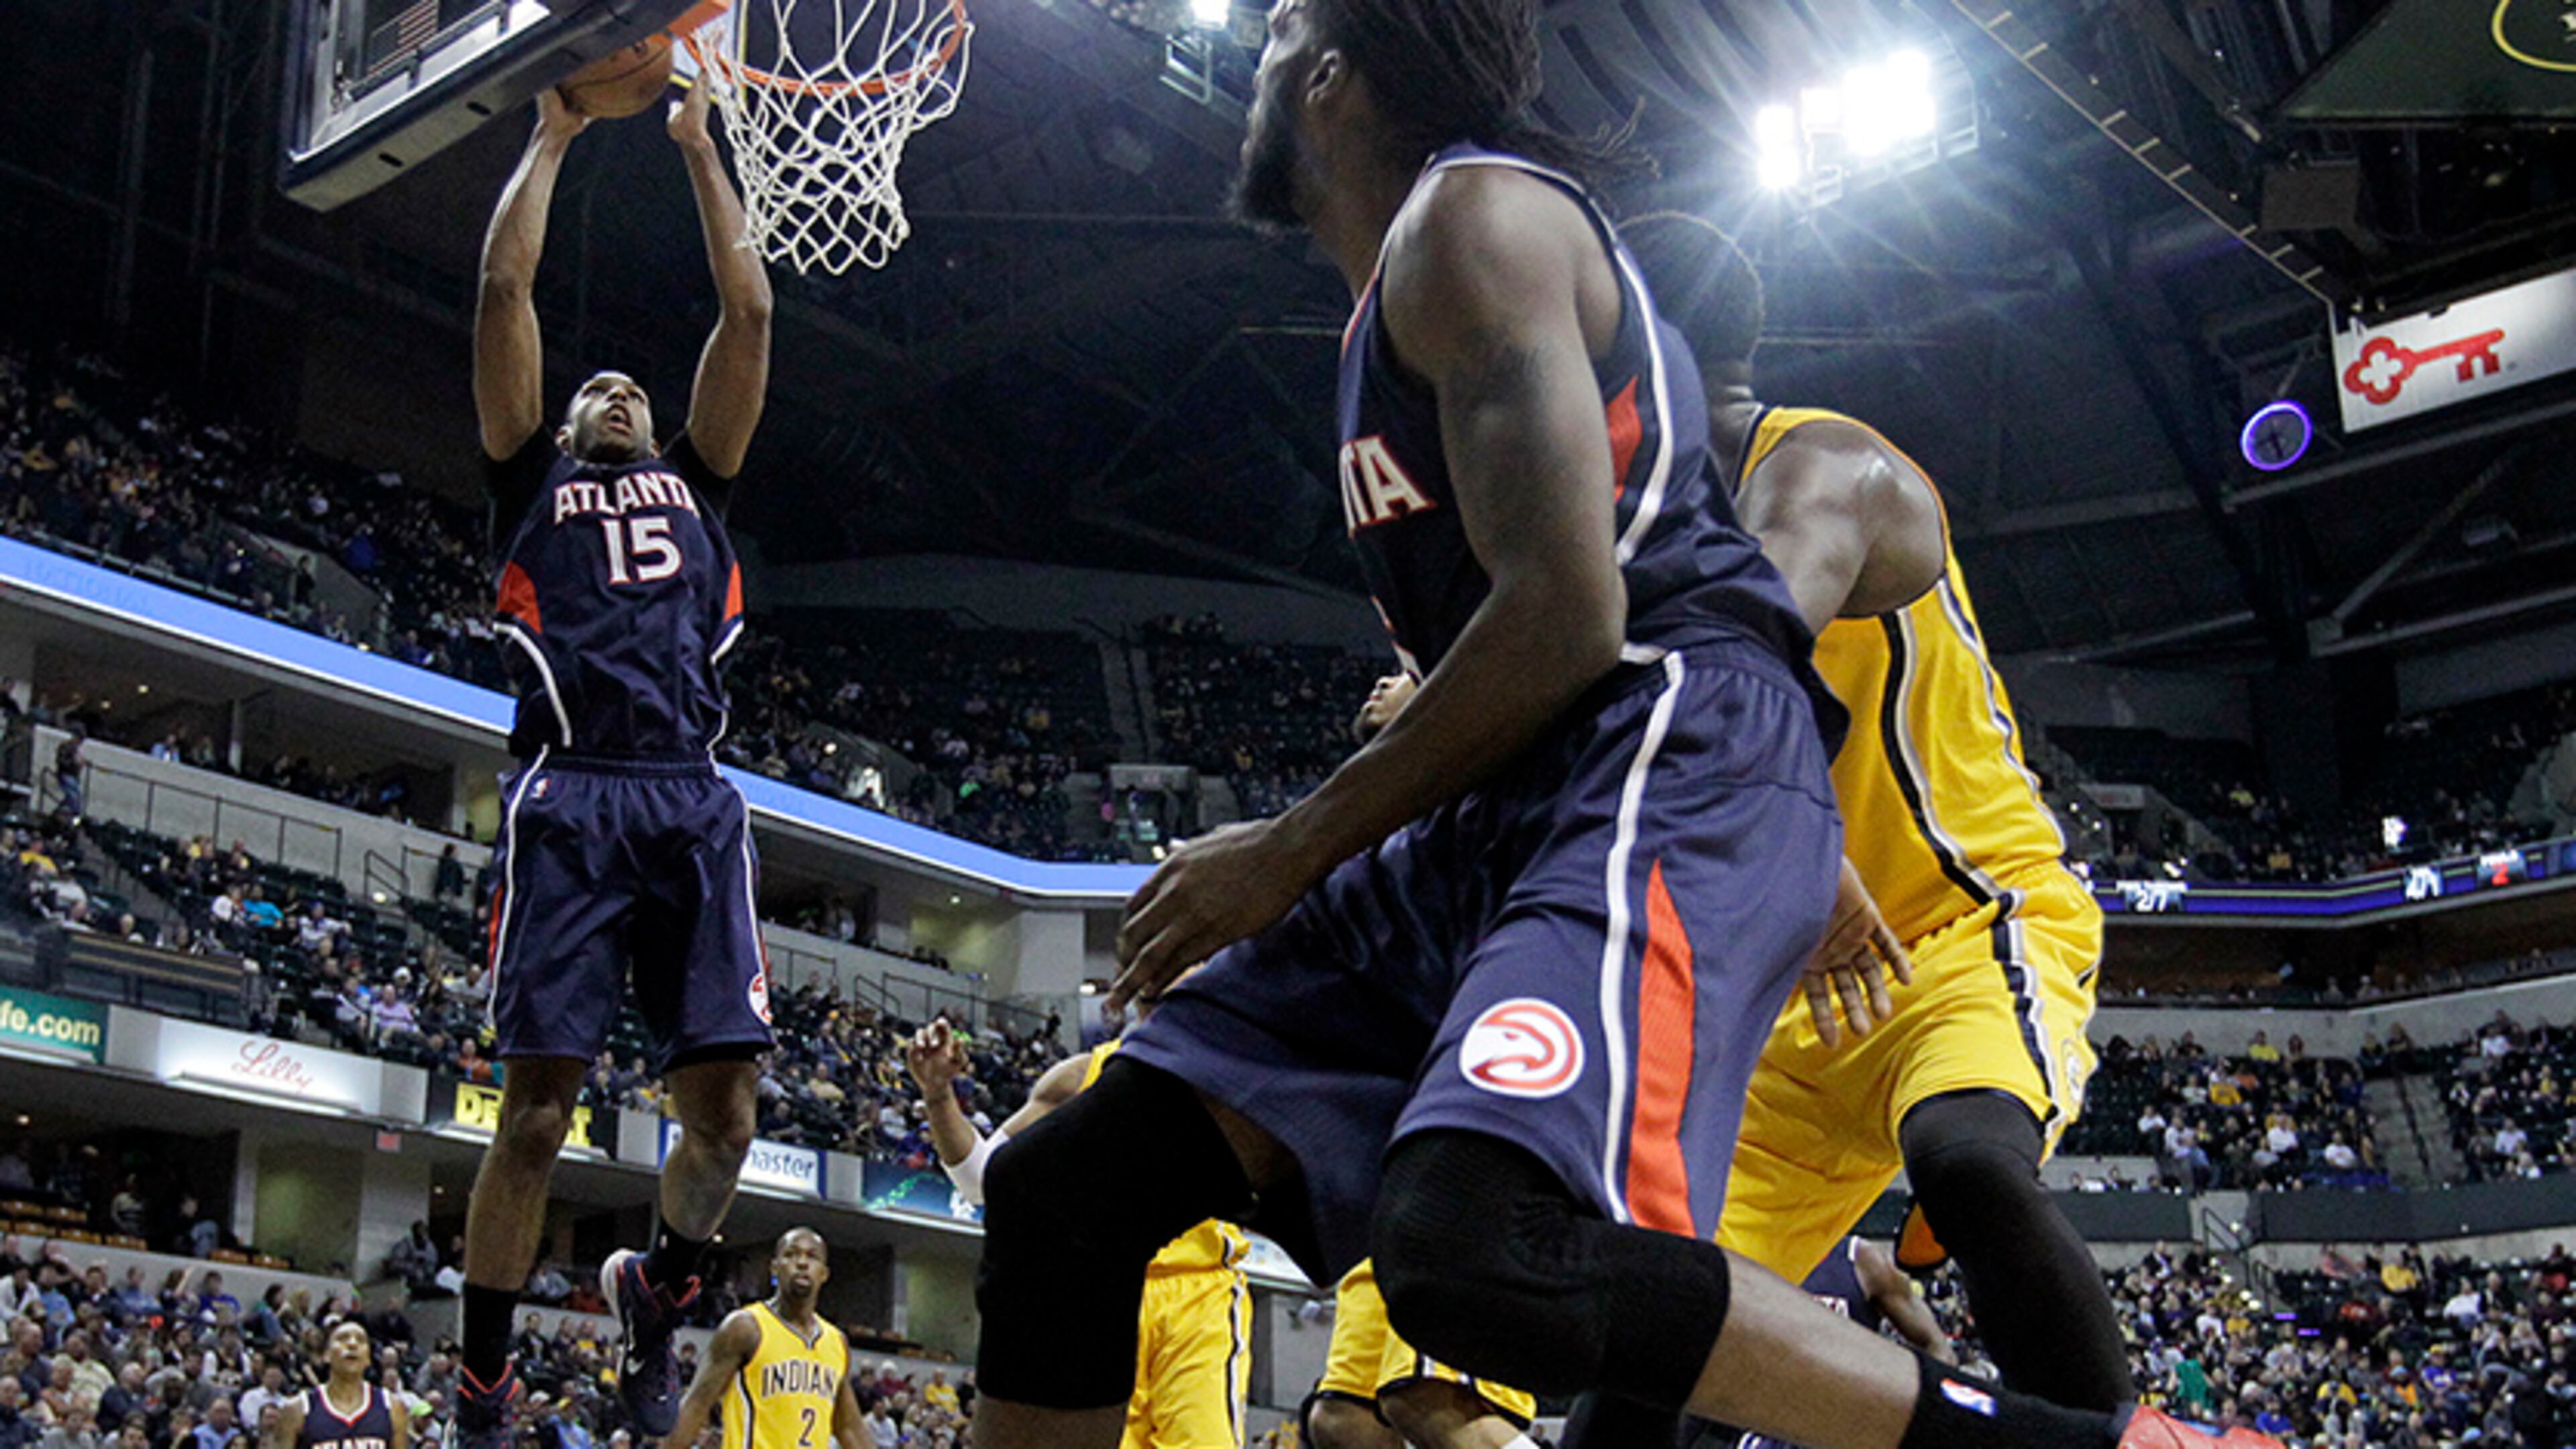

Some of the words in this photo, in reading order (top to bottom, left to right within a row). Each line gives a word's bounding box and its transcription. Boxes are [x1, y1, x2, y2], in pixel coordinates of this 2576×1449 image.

[602, 515, 683, 584] 15
[231, 1040, 313, 1095] Lilly
[798, 1407, 816, 1448] 2
